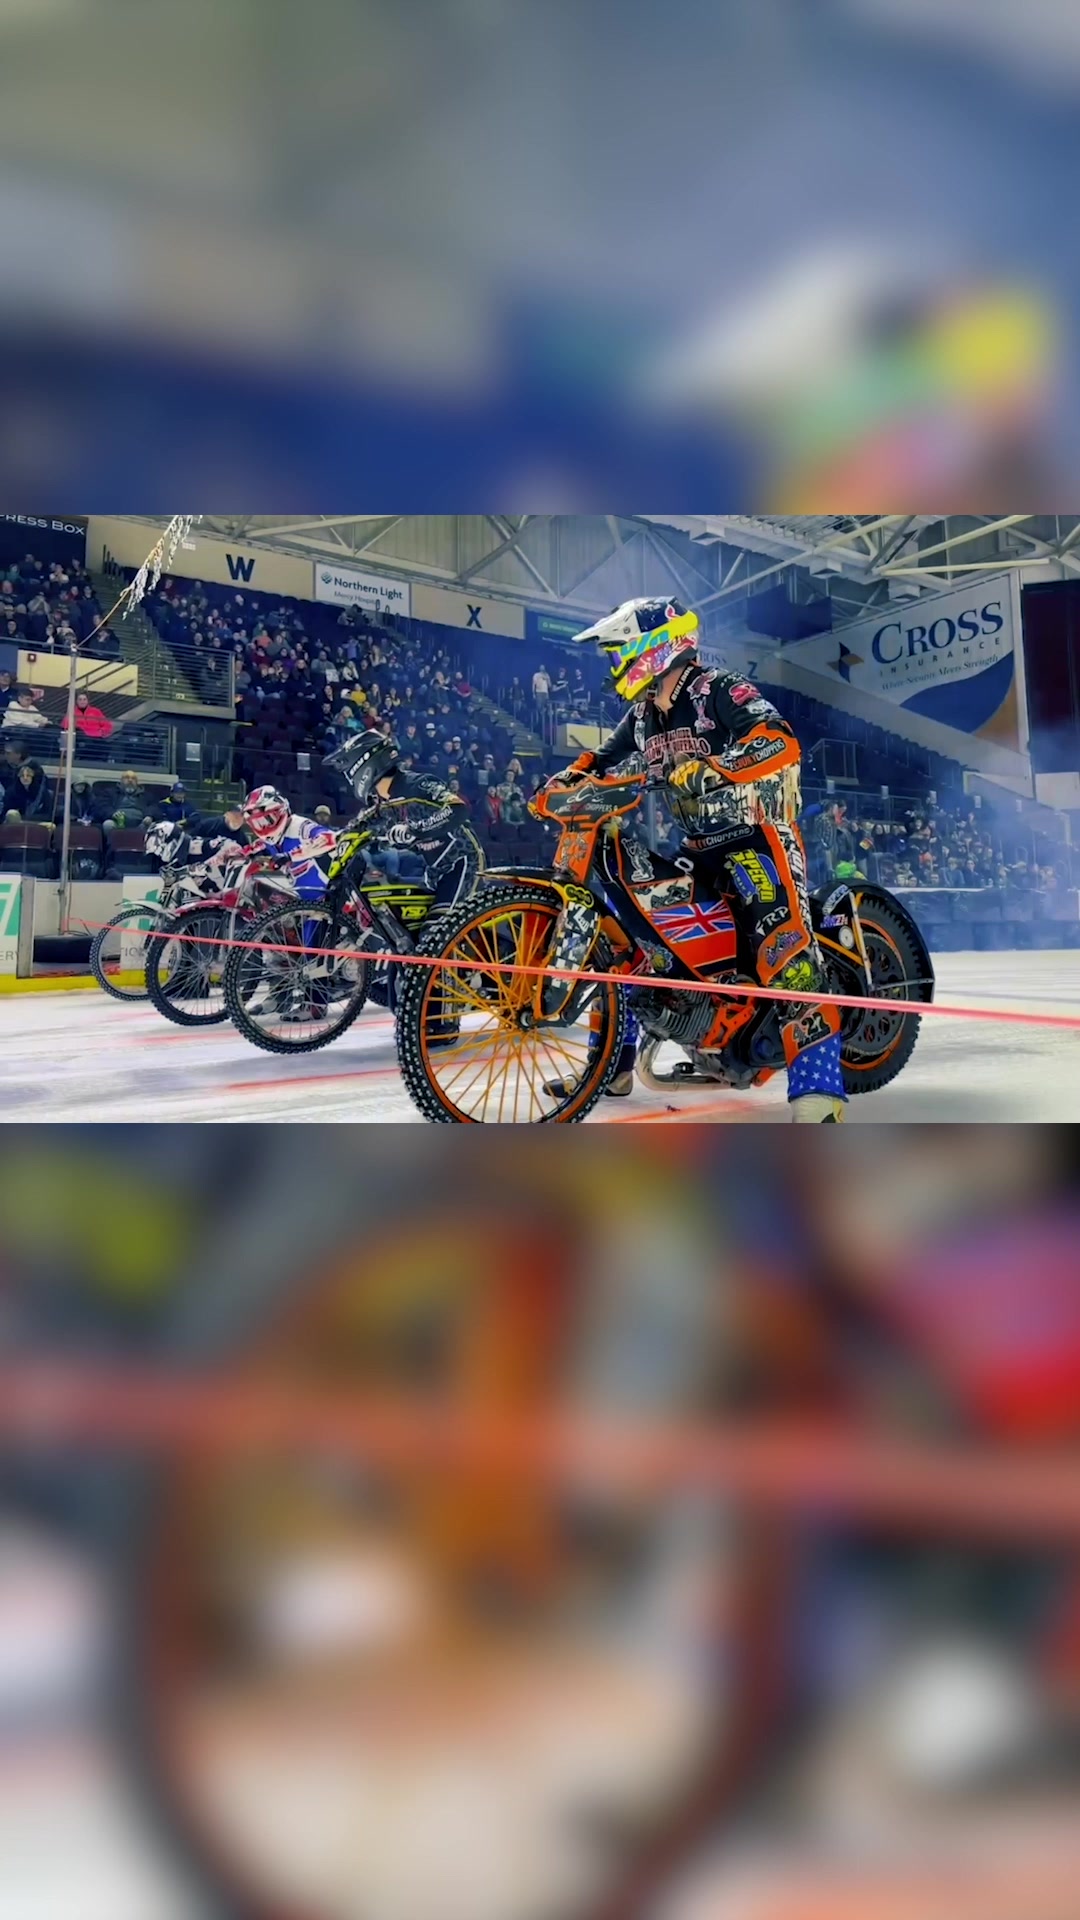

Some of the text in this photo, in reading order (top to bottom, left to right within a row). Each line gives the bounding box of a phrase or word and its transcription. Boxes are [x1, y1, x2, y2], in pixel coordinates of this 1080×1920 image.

[0, 514, 48, 528] RESS
[225, 553, 256, 583] W
[334, 577, 403, 600] Northern Light
[466, 604, 482, 629] X
[879, 637, 1000, 678] INSURANCE
[747, 661, 758, 680] Z
